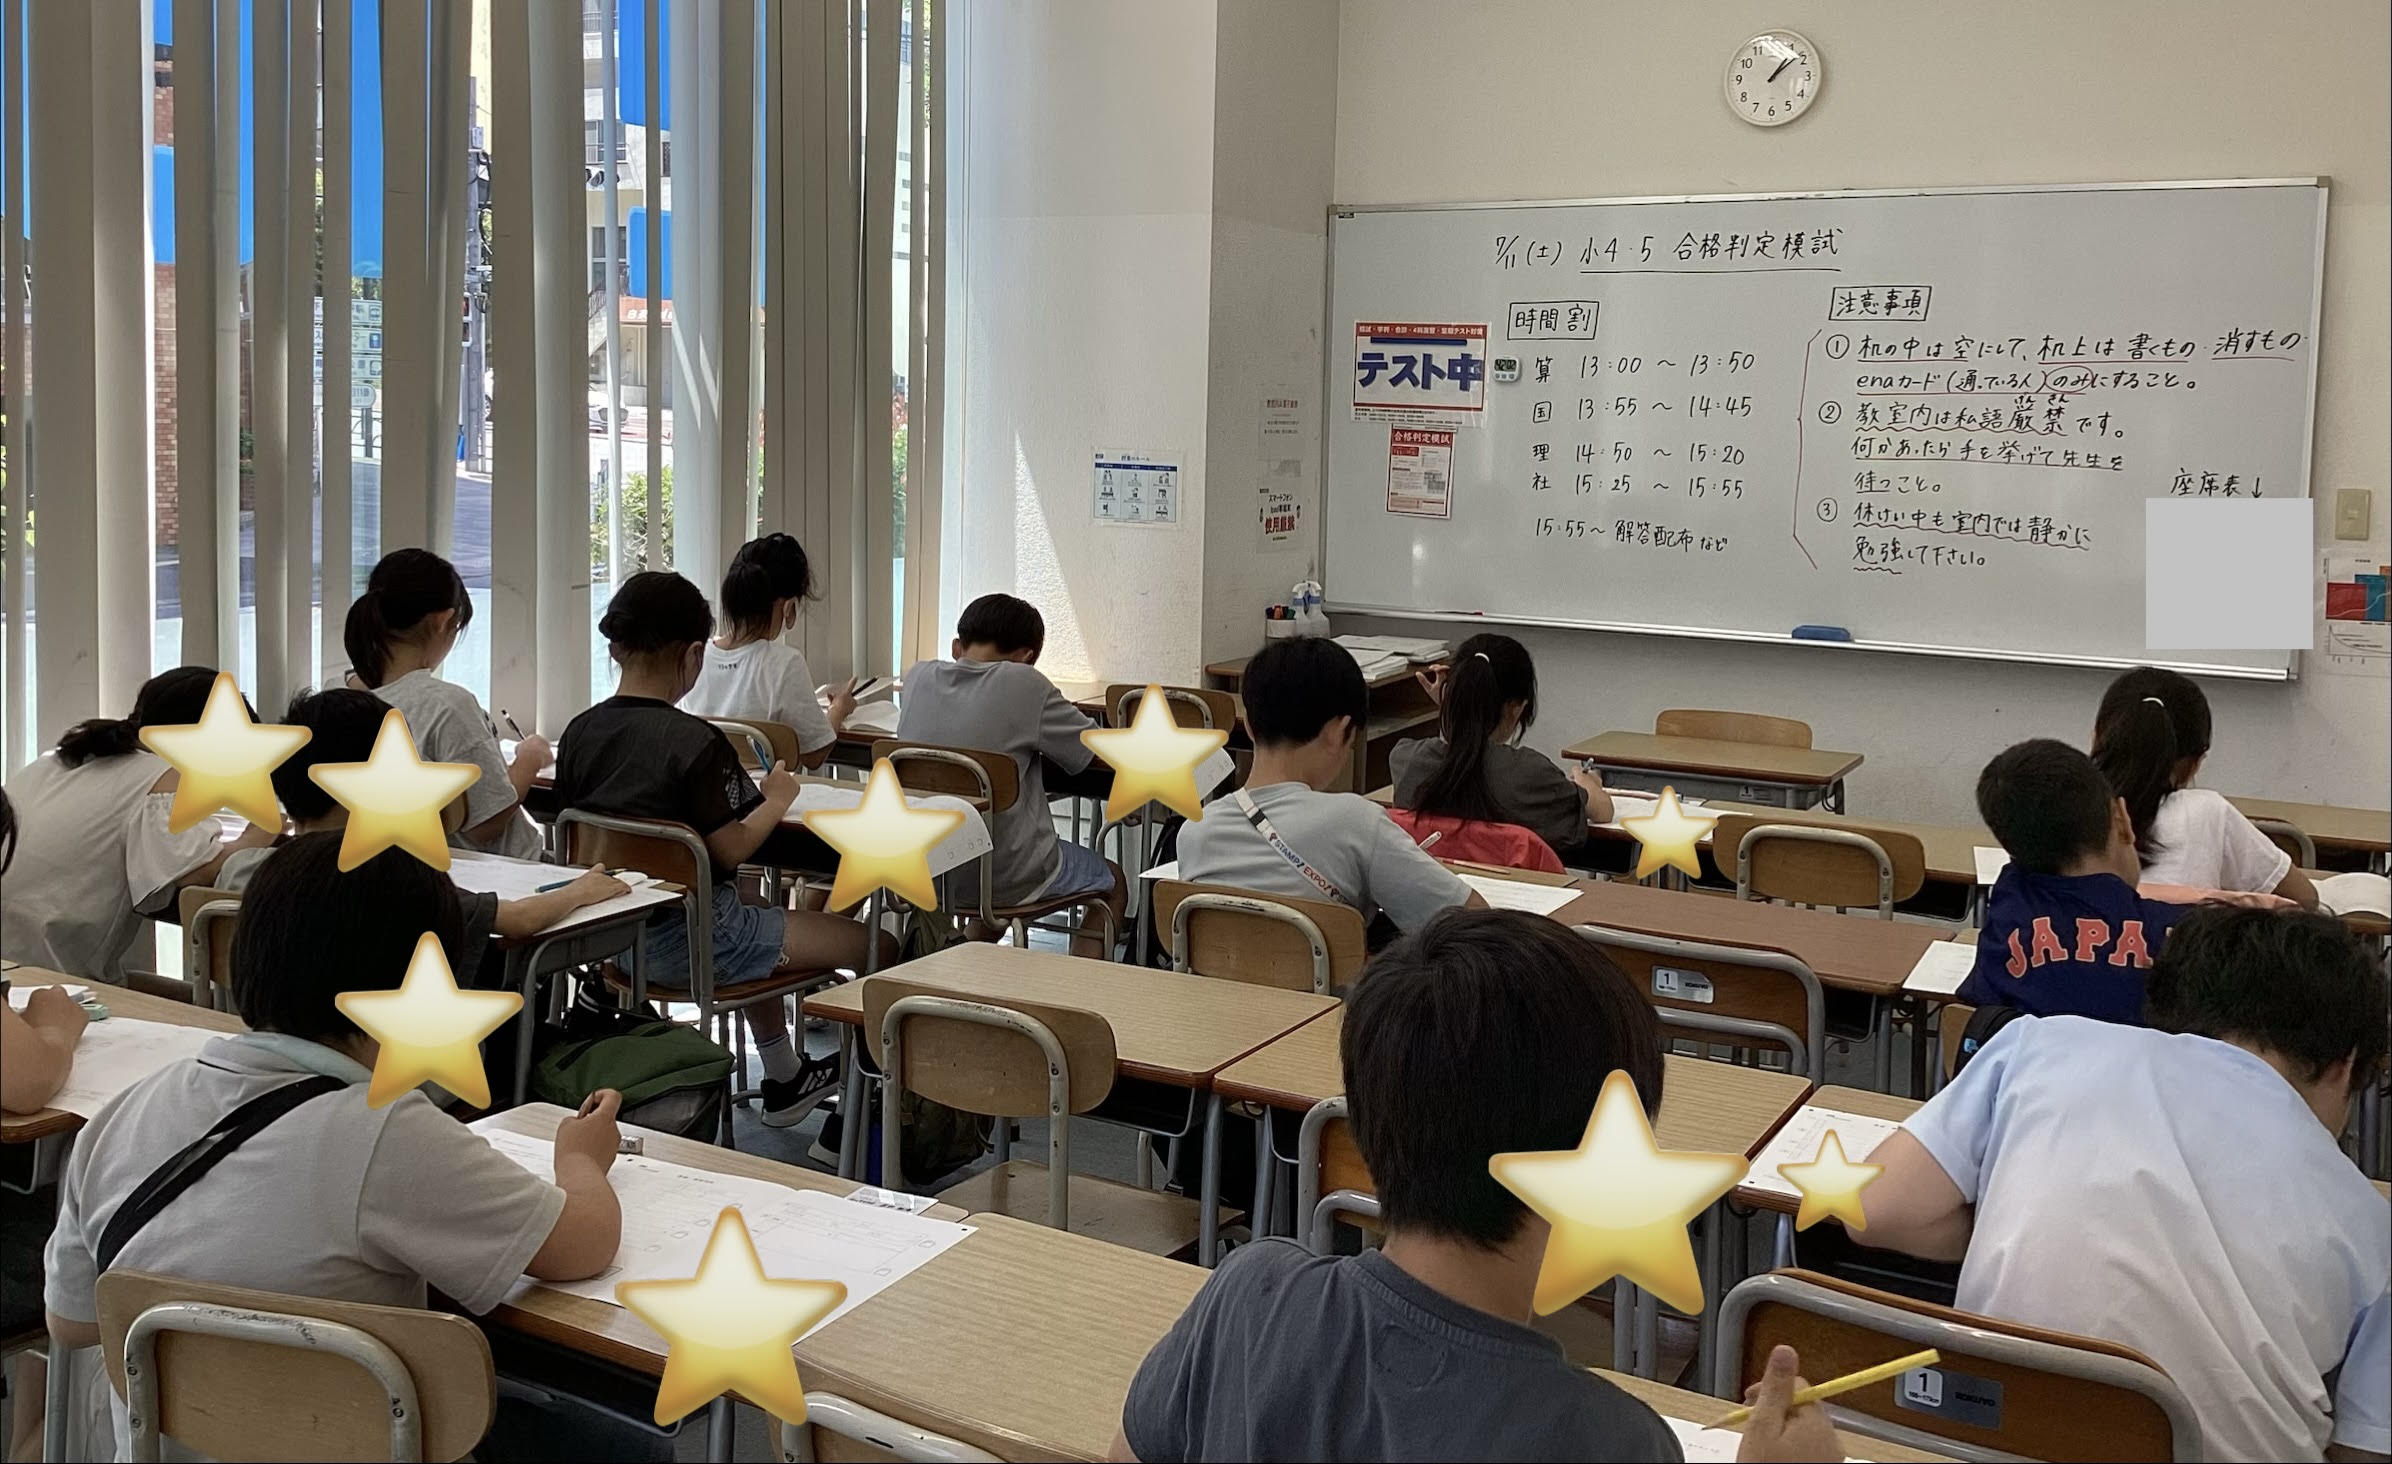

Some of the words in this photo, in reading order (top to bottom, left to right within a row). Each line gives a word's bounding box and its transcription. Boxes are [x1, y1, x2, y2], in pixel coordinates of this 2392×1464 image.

[1753, 46, 1763, 56] 11
[1799, 54, 1808, 66] 2
[1740, 57, 1753, 69] 10
[1735, 74, 1743, 86] 9
[1804, 70, 1812, 82] 3
[1740, 91, 1748, 103] 8
[1797, 88, 1805, 99] 4
[1752, 102, 1760, 113] 7
[1767, 105, 1776, 117] 6
[1785, 100, 1792, 112] 5
[1672, 228, 1844, 263] 合格判定模試
[1835, 288, 1923, 317] 注意事項
[1514, 303, 1591, 335] 時間割
[1357, 352, 1484, 393] テスト中
[1535, 356, 1553, 383] 算
[1580, 355, 1642, 378] 13:00
[1690, 351, 1755, 377] 13:50
[1532, 400, 1552, 424] 国
[1578, 396, 1638, 421] 13:55
[1689, 395, 1753, 418] 14:45
[1532, 443, 1550, 463] 理
[1576, 441, 1633, 464] 14:50
[1689, 443, 1745, 465] 15:20
[1532, 472, 1551, 491] 社
[1576, 473, 1631, 495] 15:25
[1688, 476, 1744, 499] 15:55
[2170, 467, 2243, 497] 座席表
[2006, 916, 2173, 979] JAPA
[1918, 1372, 1928, 1393] 1
